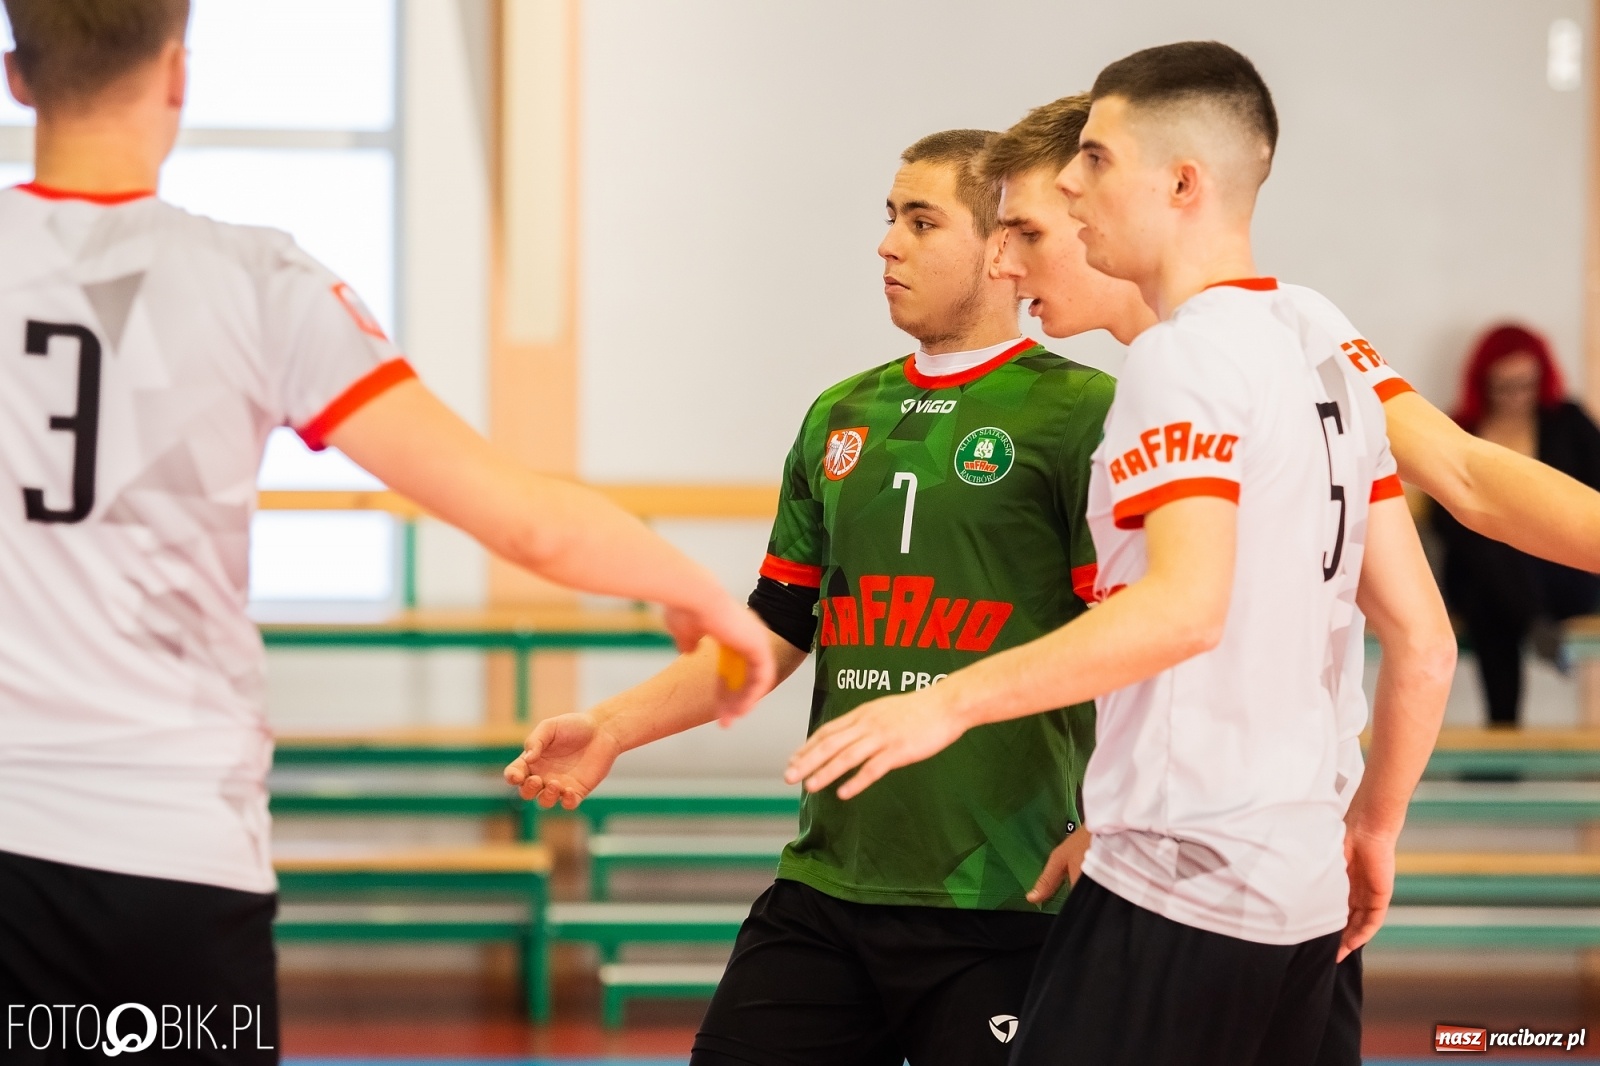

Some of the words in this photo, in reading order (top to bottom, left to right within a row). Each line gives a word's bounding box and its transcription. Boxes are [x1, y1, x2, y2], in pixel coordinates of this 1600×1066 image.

[23, 319, 102, 524] 3
[960, 432, 978, 451] KLUB
[979, 429, 1012, 456] SIATKARSKI
[1109, 421, 1239, 485] RAFAKO
[892, 472, 918, 553] 7
[1315, 401, 1345, 582] 5
[837, 669, 891, 690] GRUPA
